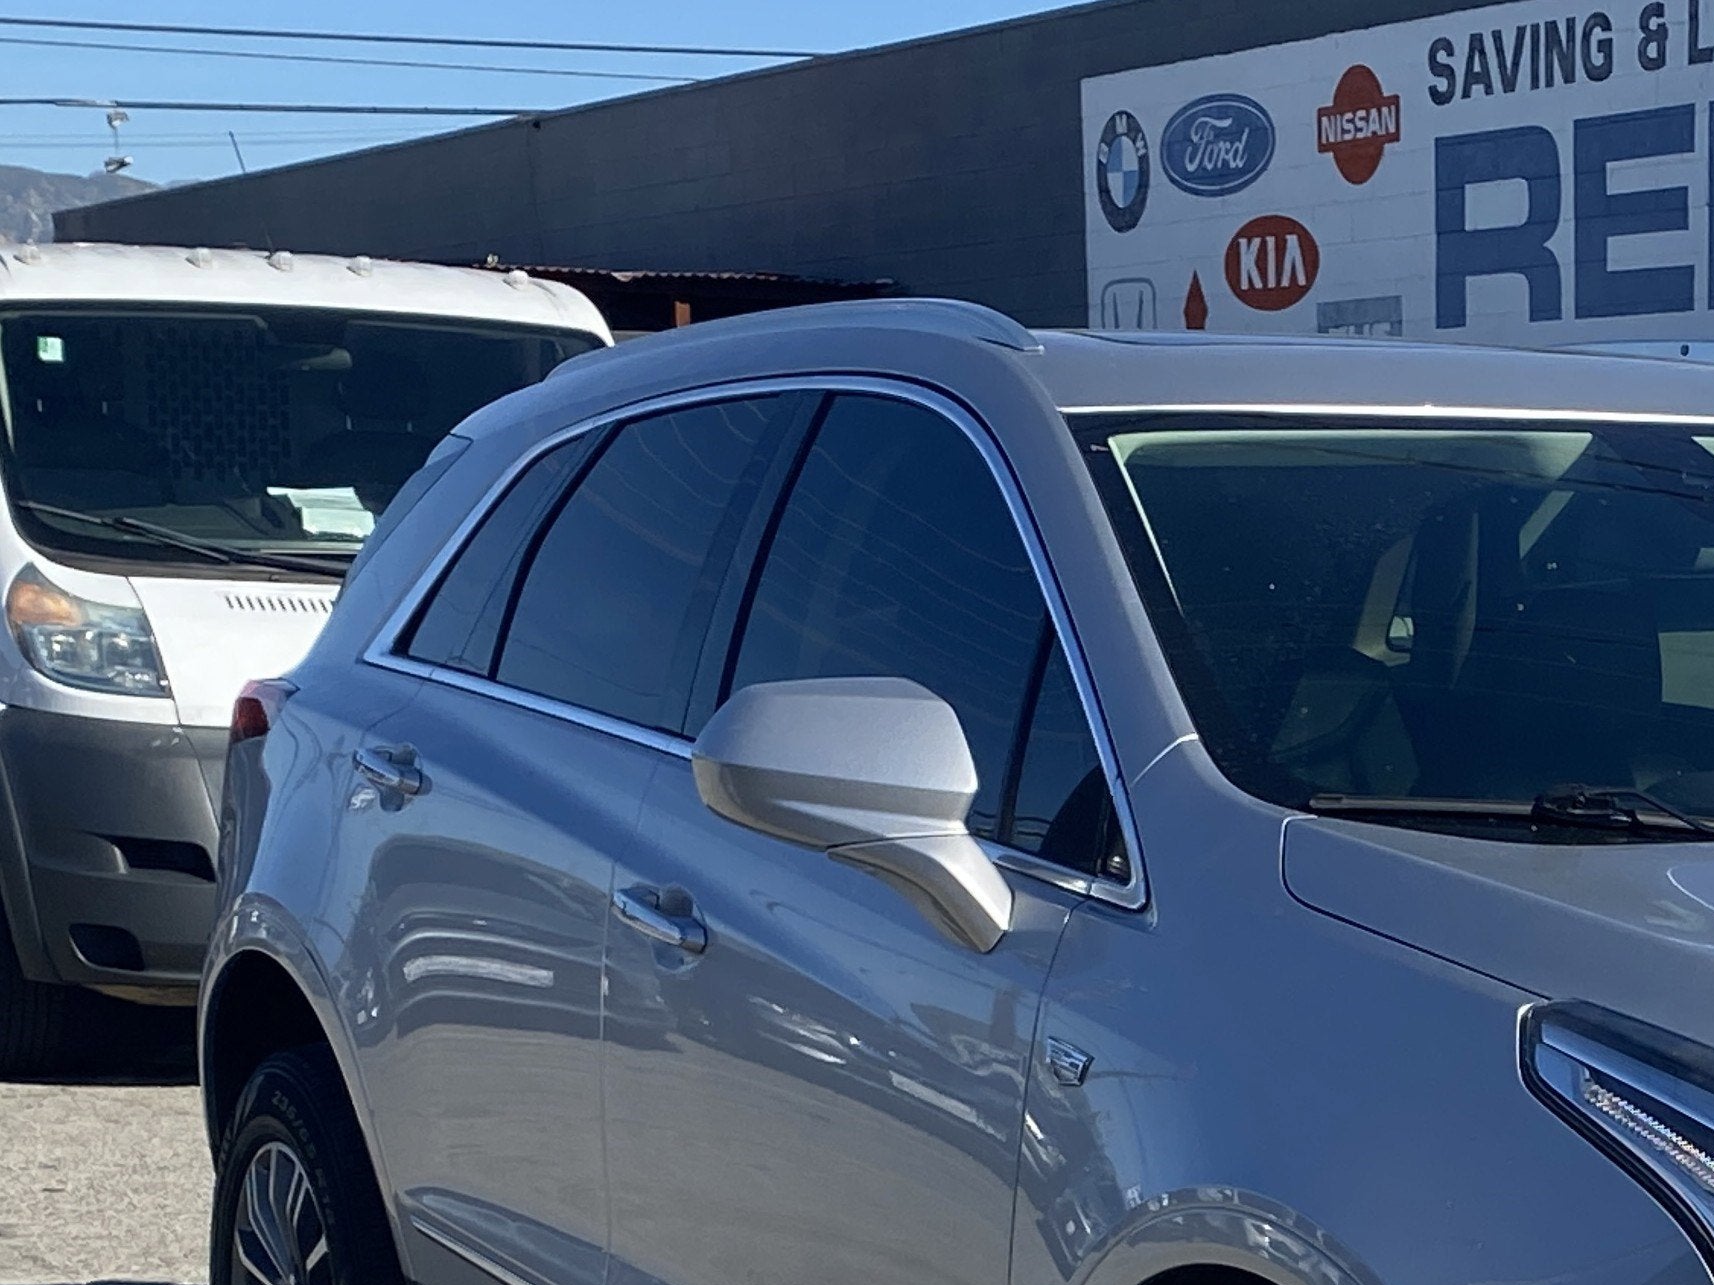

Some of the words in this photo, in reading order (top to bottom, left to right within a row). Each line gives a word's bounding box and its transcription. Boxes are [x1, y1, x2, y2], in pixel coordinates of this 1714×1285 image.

[1428, 11, 1614, 106] SAVING
[1637, 1, 1669, 72] &
[1184, 116, 1249, 173] Ford
[1319, 104, 1397, 145] NISSAN
[1238, 233, 1307, 291] KIA
